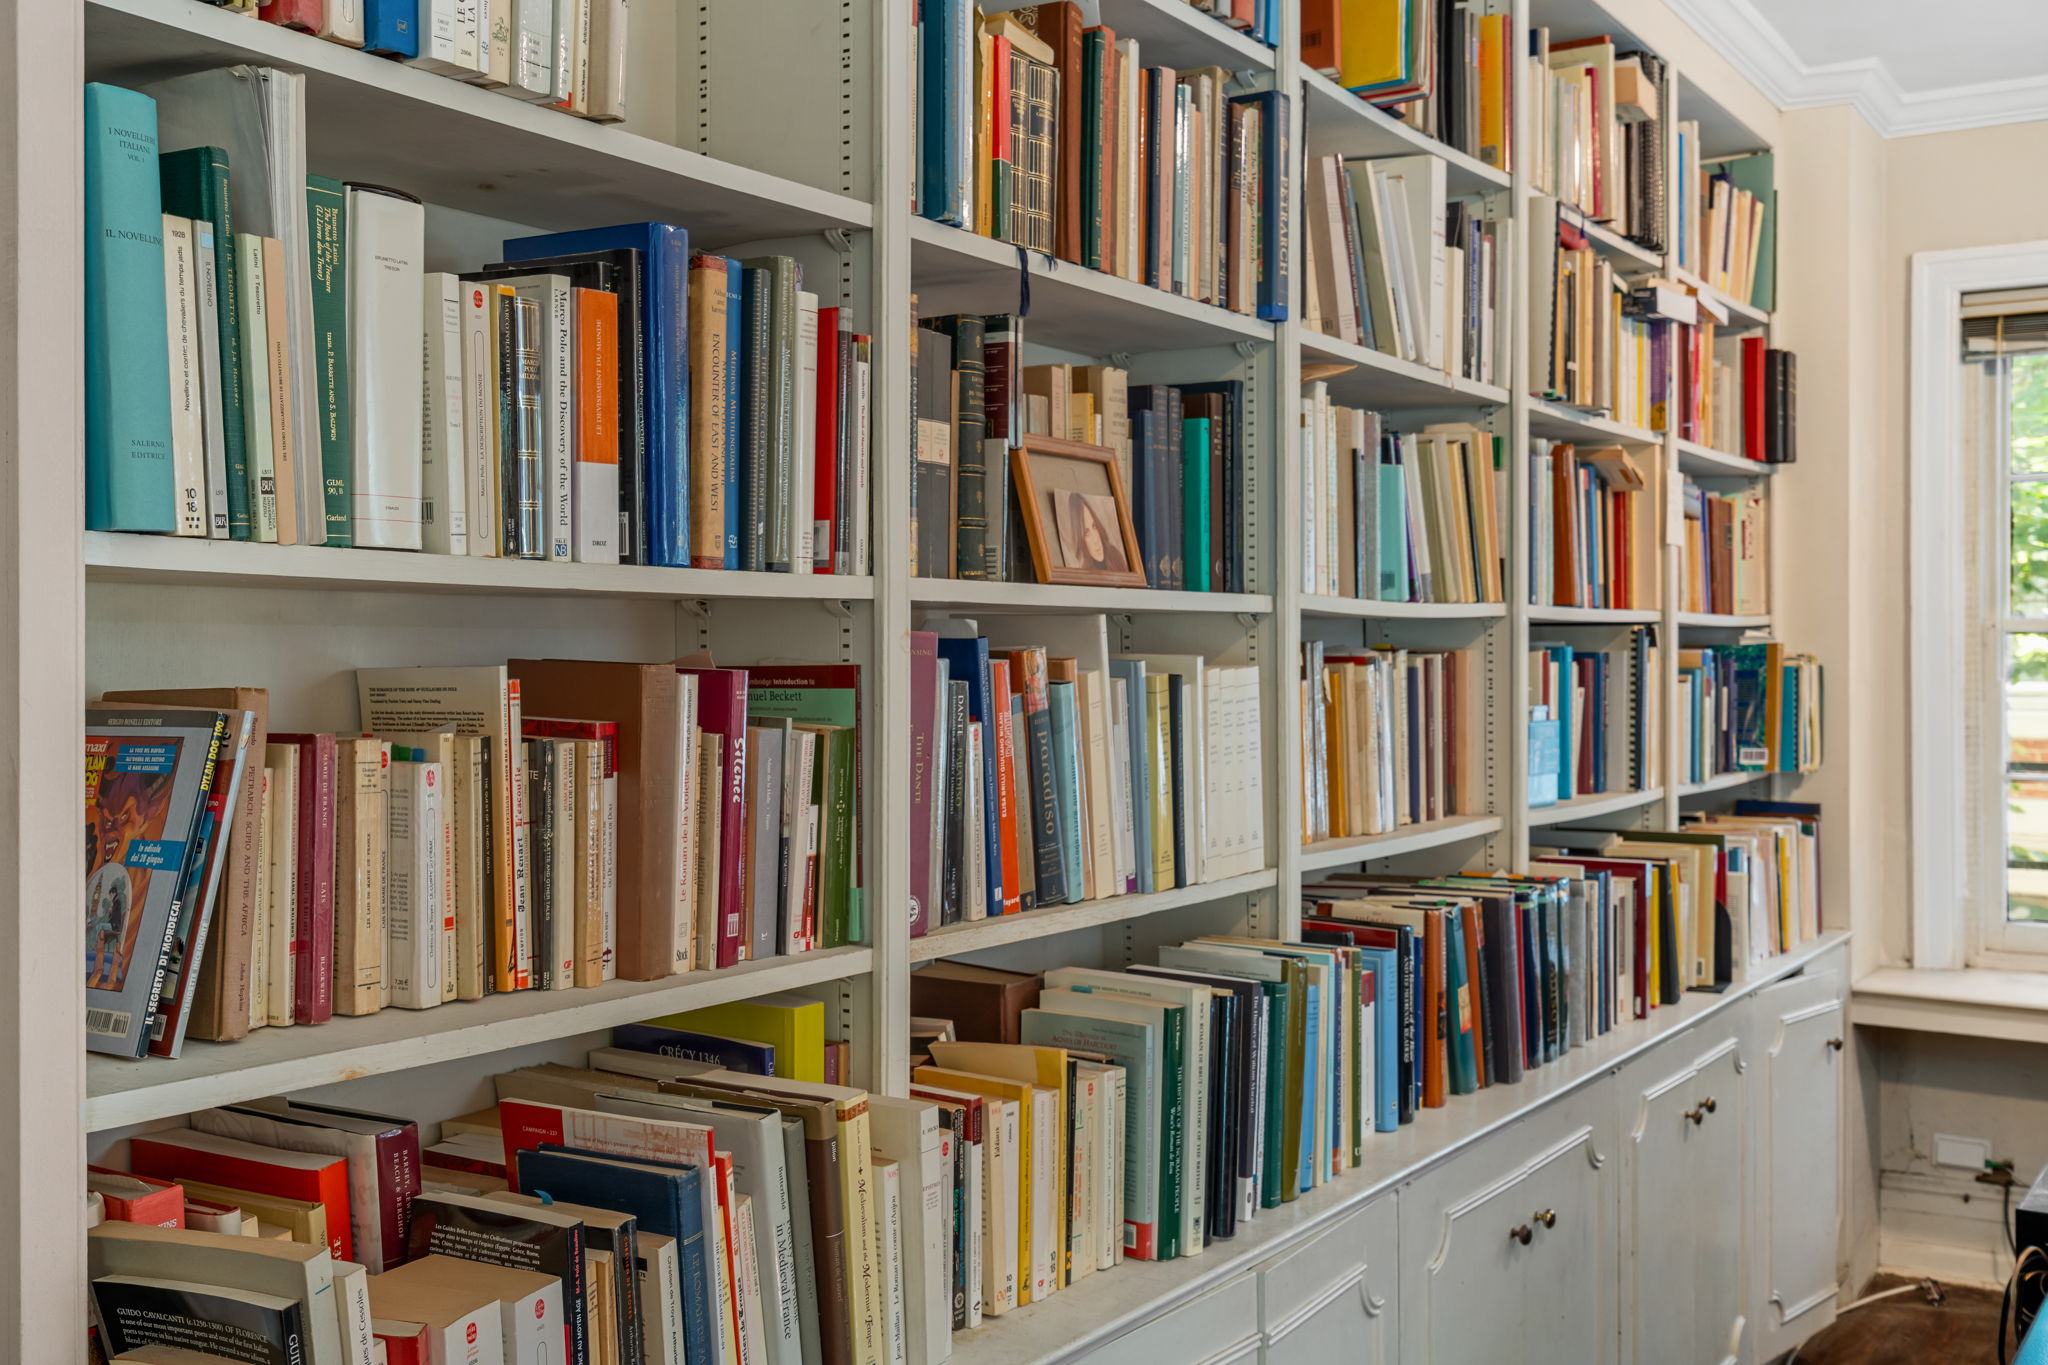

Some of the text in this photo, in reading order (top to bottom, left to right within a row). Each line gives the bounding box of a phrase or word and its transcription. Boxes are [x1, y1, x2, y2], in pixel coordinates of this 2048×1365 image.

[457, 8, 465, 24] LE
[468, 6, 475, 24] LA
[460, 49, 472, 57] 2006
[119, 140, 150, 153] ITALIANI
[106, 229, 116, 238] IL
[172, 230, 186, 238] 1928
[1279, 175, 1288, 276] PETRARCH
[315, 256, 324, 280] Tresor)
[324, 264, 332, 293] Treasure
[178, 287, 185, 296] du
[558, 289, 566, 325] Marco
[181, 334, 187, 343] de
[559, 328, 567, 352] Polo
[596, 353, 601, 366] DU
[711, 405, 719, 419] OF
[558, 400, 567, 455] Discovery
[596, 424, 602, 434] LE
[132, 440, 165, 448] SALERNO
[132, 452, 166, 460] EDITRICE
[559, 458, 567, 471] of
[559, 472, 567, 489] the
[185, 488, 197, 499] 10
[186, 501, 197, 512] 18
[559, 494, 568, 526] World
[749, 691, 802, 701] nuel Beckett
[86, 741, 108, 752] maxi
[200, 720, 224, 791] DYLAN DOG 190
[732, 736, 743, 803] Silence
[911, 732, 924, 804] THE DANTE
[322, 782, 327, 794] DE
[1036, 730, 1055, 836] paradiso
[514, 767, 522, 827] L'escoufle
[681, 815, 688, 825] la
[244, 821, 252, 850] SCIPIO
[681, 829, 688, 842] de
[138, 843, 162, 853] In edicola
[139, 854, 146, 862] 28
[146, 855, 164, 865] giugno
[242, 854, 251, 875] AND
[241, 879, 249, 900] THE
[680, 889, 686, 902] Le
[239, 902, 248, 936] AFRICA
[144, 900, 181, 1025] IL SEGRETO DI MORDECAI
[676, 950, 688, 961] Stock
[182, 922, 208, 1014] VENDETTE INCROCIATE
[658, 1040, 722, 1066] CRÉCY 1346
[1175, 1118, 1180, 1128] OF
[993, 1126, 1001, 1157] Fabliaux
[830, 1140, 838, 1162] Dillon
[392, 1152, 401, 1182] BEACH
[401, 1150, 412, 1222] BARNEY, LEWIS,
[777, 1166, 787, 1210] Butterfield
[857, 1178, 868, 1236] Medievalism
[394, 1196, 405, 1238] BERGHOF
[892, 1251, 898, 1262] du
[1050, 1251, 1056, 1260] 10
[1050, 1264, 1055, 1272] 18
[776, 1223, 793, 1339] in Medieval France
[862, 1263, 873, 1313] Modernist
[893, 1293, 899, 1304] Le
[116, 1306, 268, 1343] GUIDO CAVALCANTI (c.1250-1300) OF FLORENCE
[864, 1314, 874, 1348] Temper
